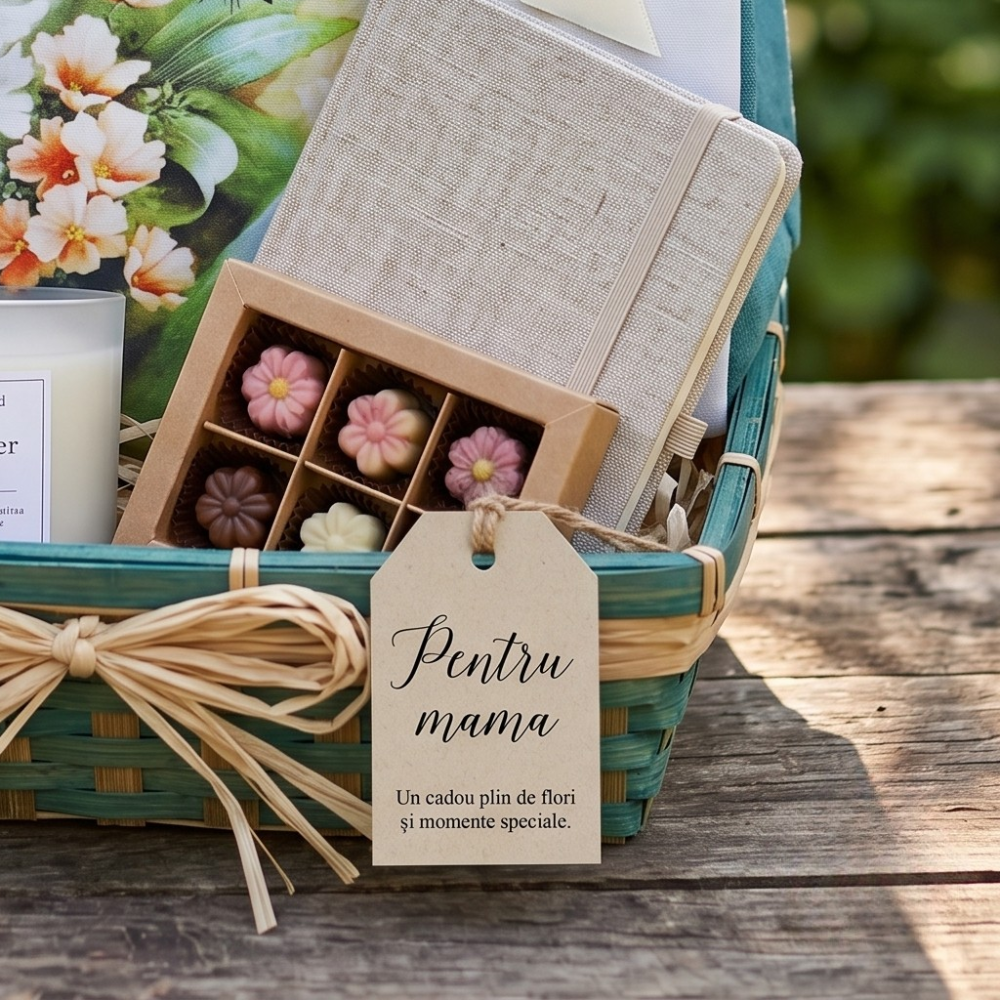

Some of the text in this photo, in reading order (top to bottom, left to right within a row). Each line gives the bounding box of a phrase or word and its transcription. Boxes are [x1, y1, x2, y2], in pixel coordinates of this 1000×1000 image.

[390, 614, 574, 690] Pentru
[415, 709, 559, 743] mama
[396, 789, 576, 809] Un cadou plin de flori
[419, 817, 496, 829] momente
[500, 813, 571, 833] speciale.
